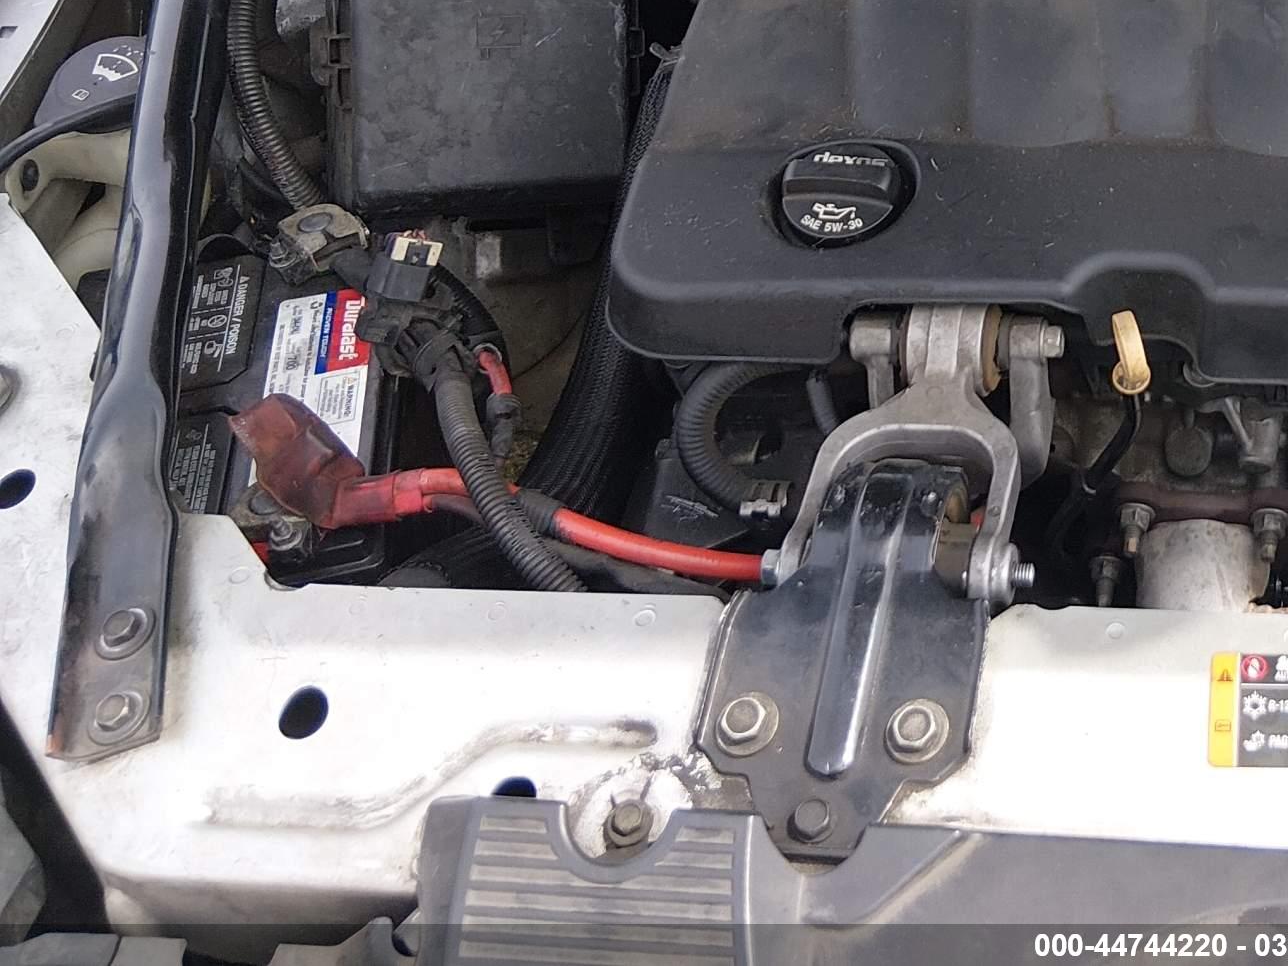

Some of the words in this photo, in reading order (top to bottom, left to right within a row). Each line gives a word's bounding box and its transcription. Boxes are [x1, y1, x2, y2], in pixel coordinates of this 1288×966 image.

[800, 214, 823, 230] SAE
[824, 218, 864, 233] 5W-30
[232, 283, 249, 318] DANGER
[225, 323, 240, 355] POISON
[285, 356, 298, 371] 700
